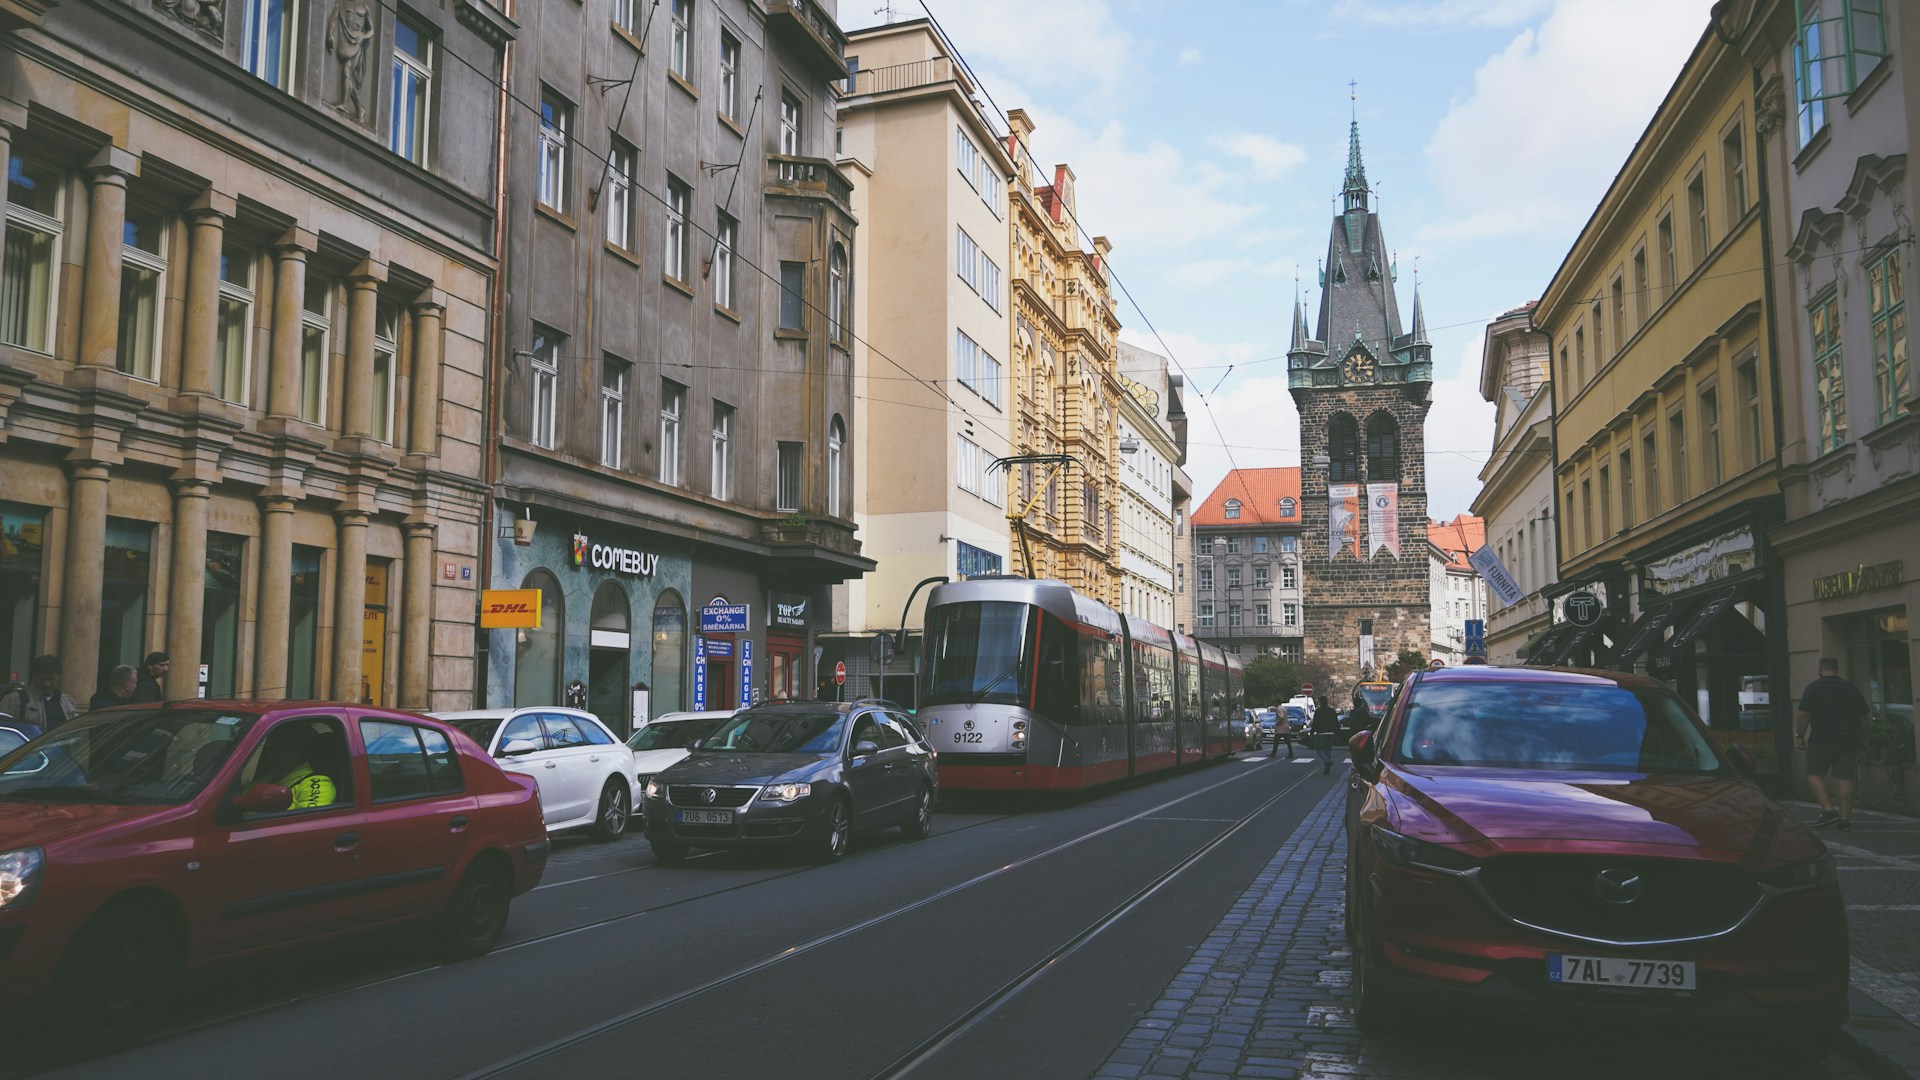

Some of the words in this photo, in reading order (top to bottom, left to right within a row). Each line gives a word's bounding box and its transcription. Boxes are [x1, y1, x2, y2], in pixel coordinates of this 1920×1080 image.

[591, 544, 658, 577] COMEBUY
[1488, 565, 1517, 600] FURNITA
[490, 603, 529, 613] DHL
[703, 606, 745, 615] EXCHANGE
[777, 604, 792, 616] TOP
[716, 614, 732, 622] 0%
[703, 622, 746, 630] SMĚNÁRNA
[695, 638, 706, 701] EXCHANGE
[742, 642, 752, 701] EXCHANGE
[694, 702, 705, 711] 0%
[953, 732, 983, 743] 9122
[684, 811, 700, 821] 7U6
[706, 812, 729, 822] 0513
[1549, 971, 1561, 979] CZ
[1567, 958, 1610, 983] 7AL
[1628, 961, 1684, 986] 7739
